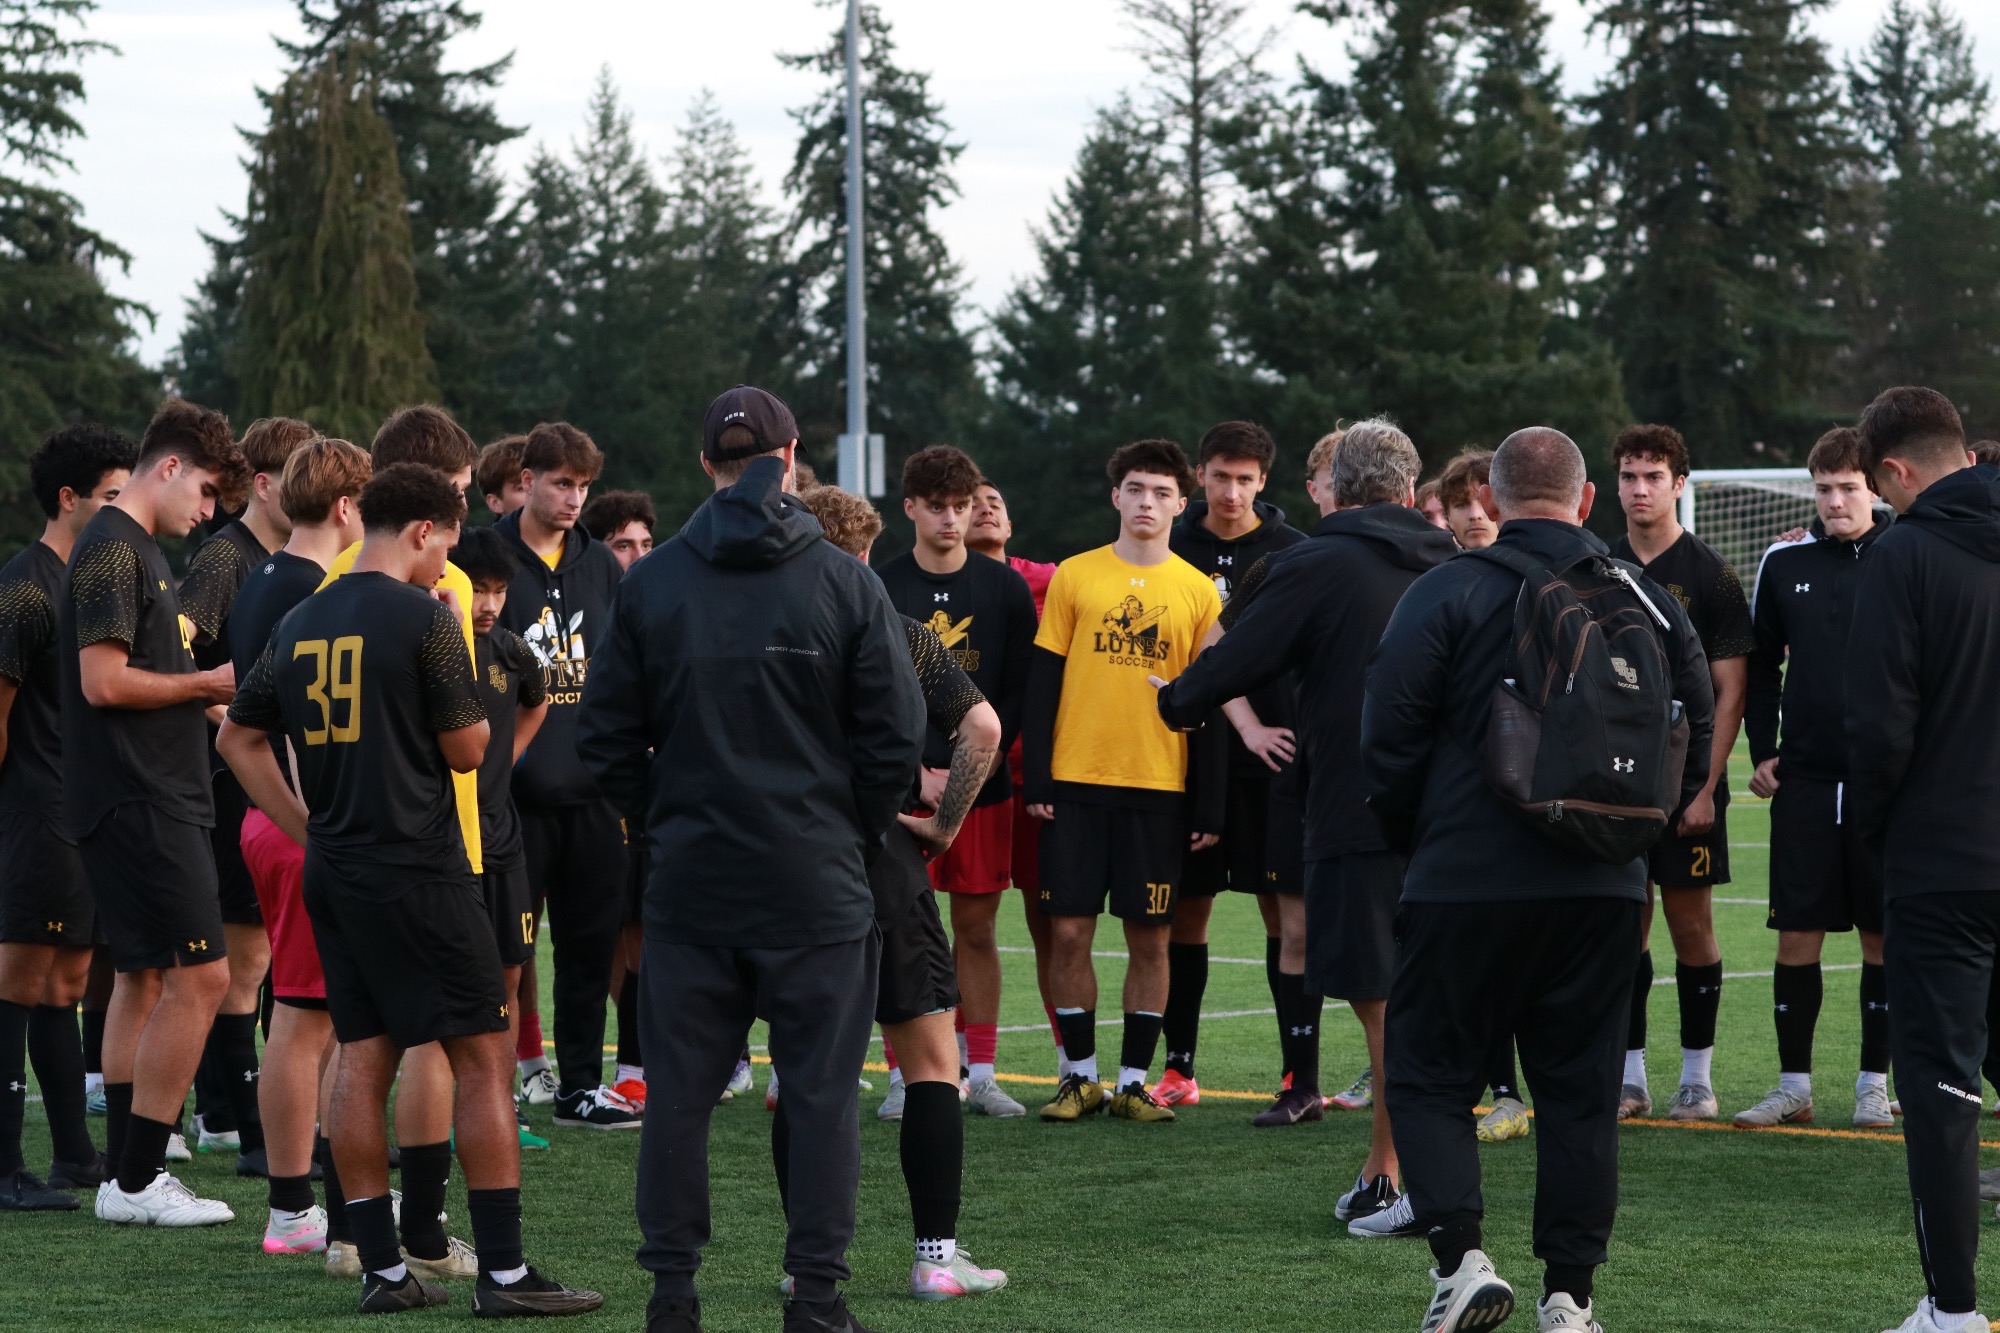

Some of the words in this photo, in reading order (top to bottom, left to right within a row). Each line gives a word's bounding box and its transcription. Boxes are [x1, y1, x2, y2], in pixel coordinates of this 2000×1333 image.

[789, 648, 819, 656] ARMOUR
[1094, 632, 1170, 660] LUTES
[537, 657, 592, 687] UTE
[1109, 655, 1155, 669] SOCCER
[293, 635, 364, 746] 39
[1617, 681, 1640, 690] SOCCER
[1691, 846, 1711, 876] 21
[1146, 883, 1171, 914] 30
[1937, 1081, 1967, 1099] UNDER
[1965, 1093, 1983, 1105] ARM
